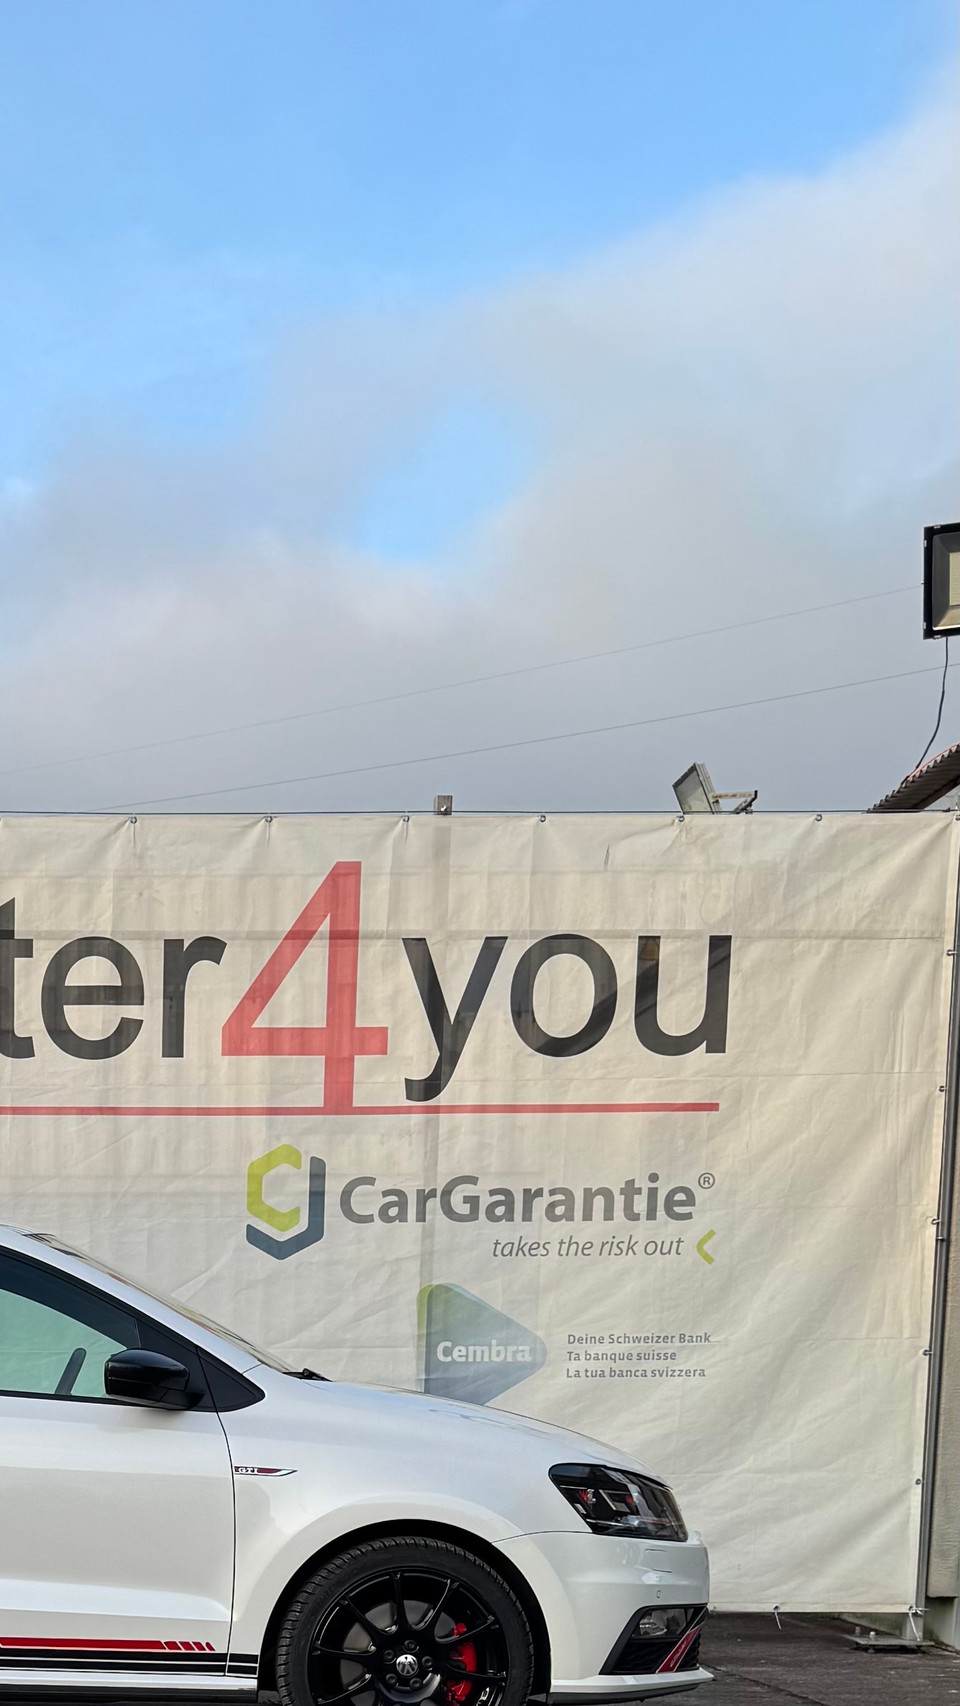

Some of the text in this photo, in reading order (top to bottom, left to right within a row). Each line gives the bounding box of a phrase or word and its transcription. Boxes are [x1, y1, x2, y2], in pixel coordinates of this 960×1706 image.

[492, 1233, 685, 1258] takes the risk out
[567, 1332, 712, 1345] Deine Schweizer Bank
[436, 1340, 533, 1363] Cembra
[567, 1350, 677, 1364] Ta banque suisse
[566, 1367, 707, 1379] La tua banca svizzera
[238, 1467, 259, 1475] GTI
